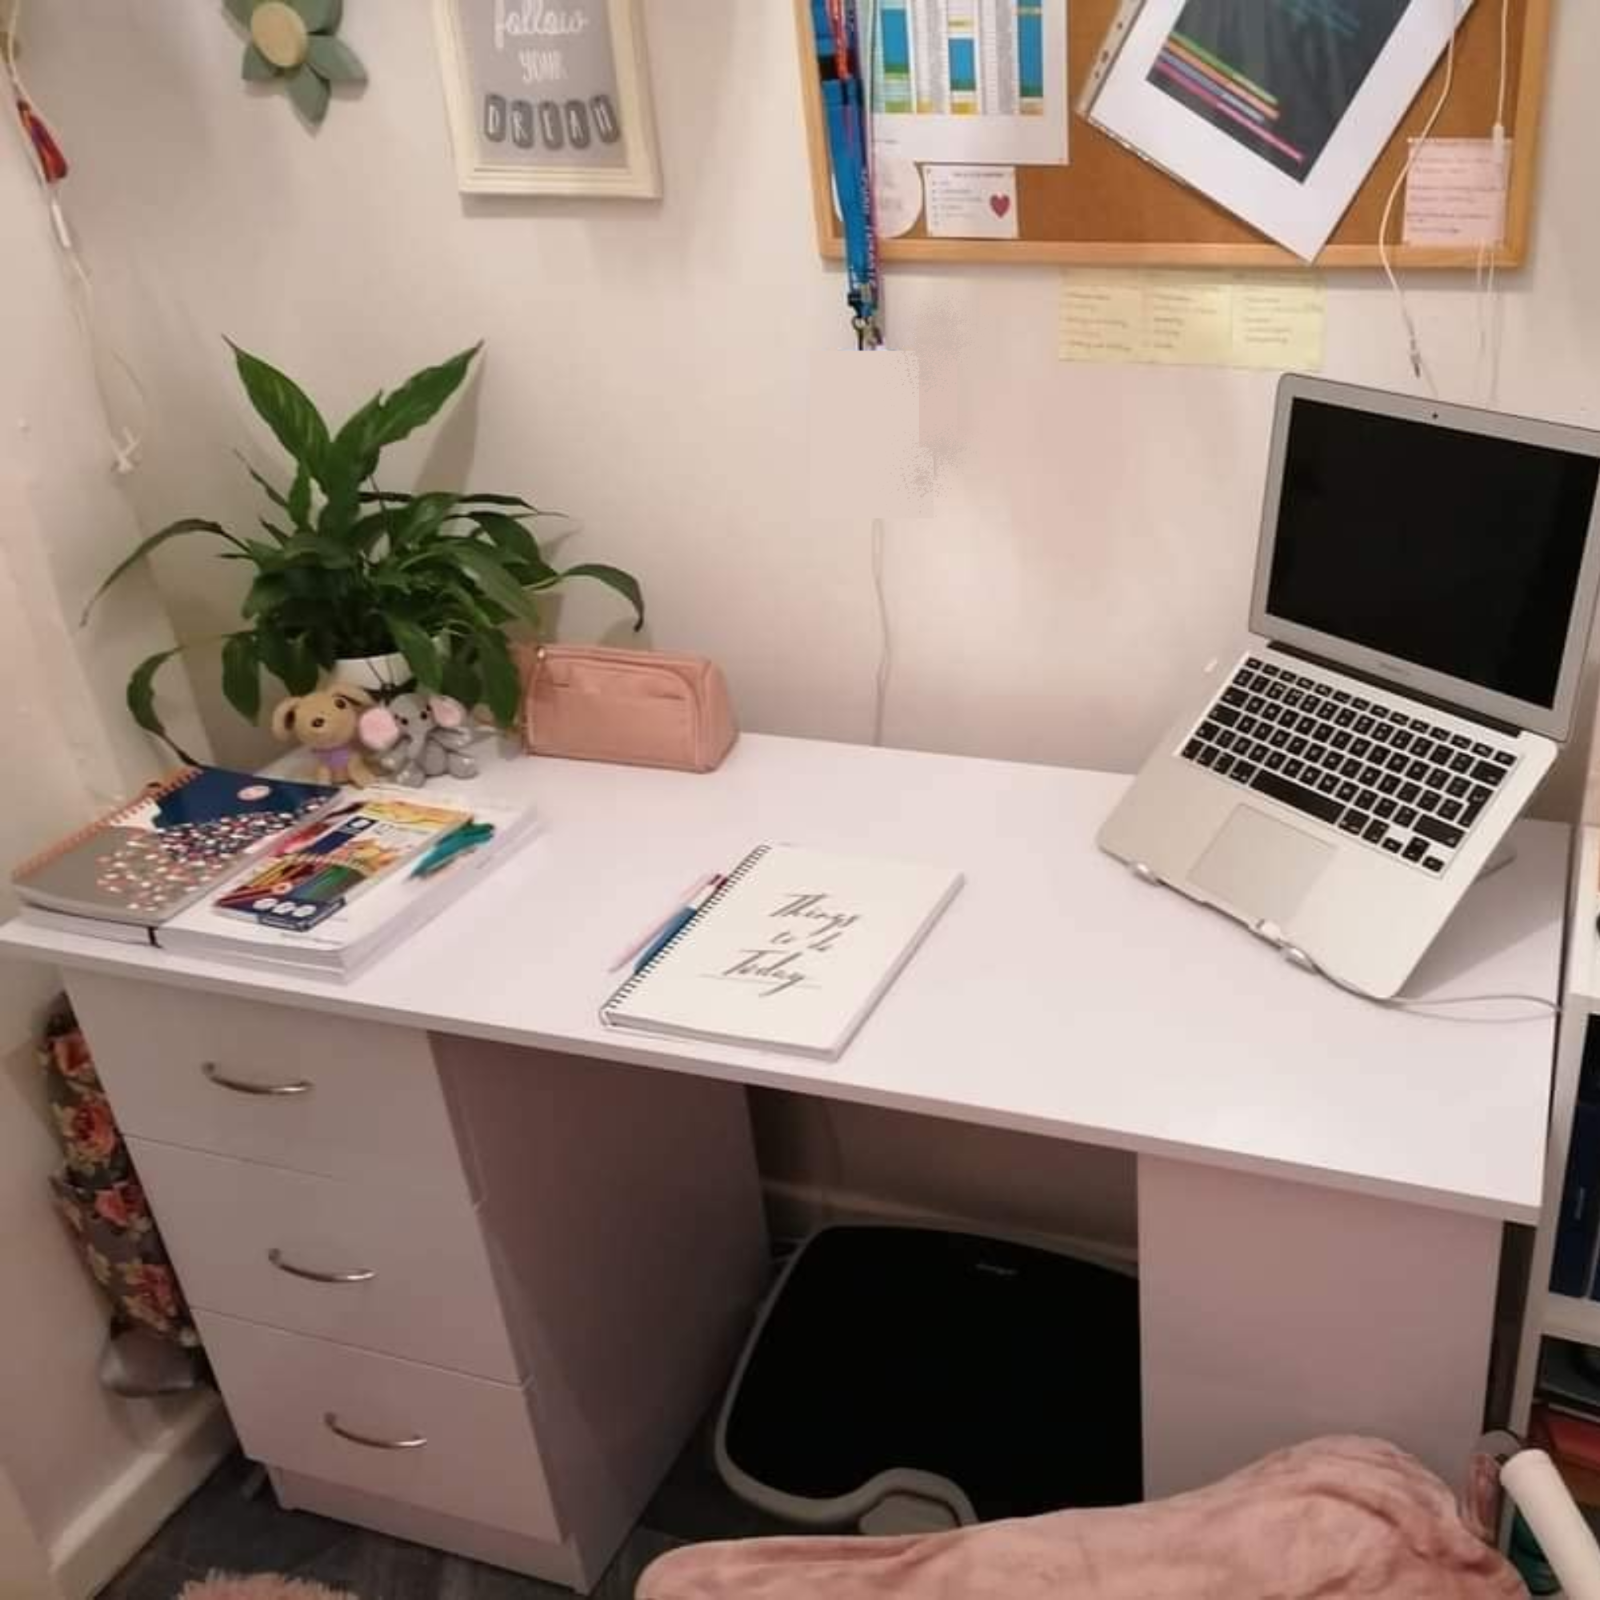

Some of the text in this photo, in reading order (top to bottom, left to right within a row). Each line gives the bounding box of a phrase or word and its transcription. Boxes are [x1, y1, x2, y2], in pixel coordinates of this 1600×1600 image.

[494, 0, 588, 49] follow
[768, 892, 862, 937] Things
[769, 930, 798, 945] to
[722, 948, 806, 998] Today
